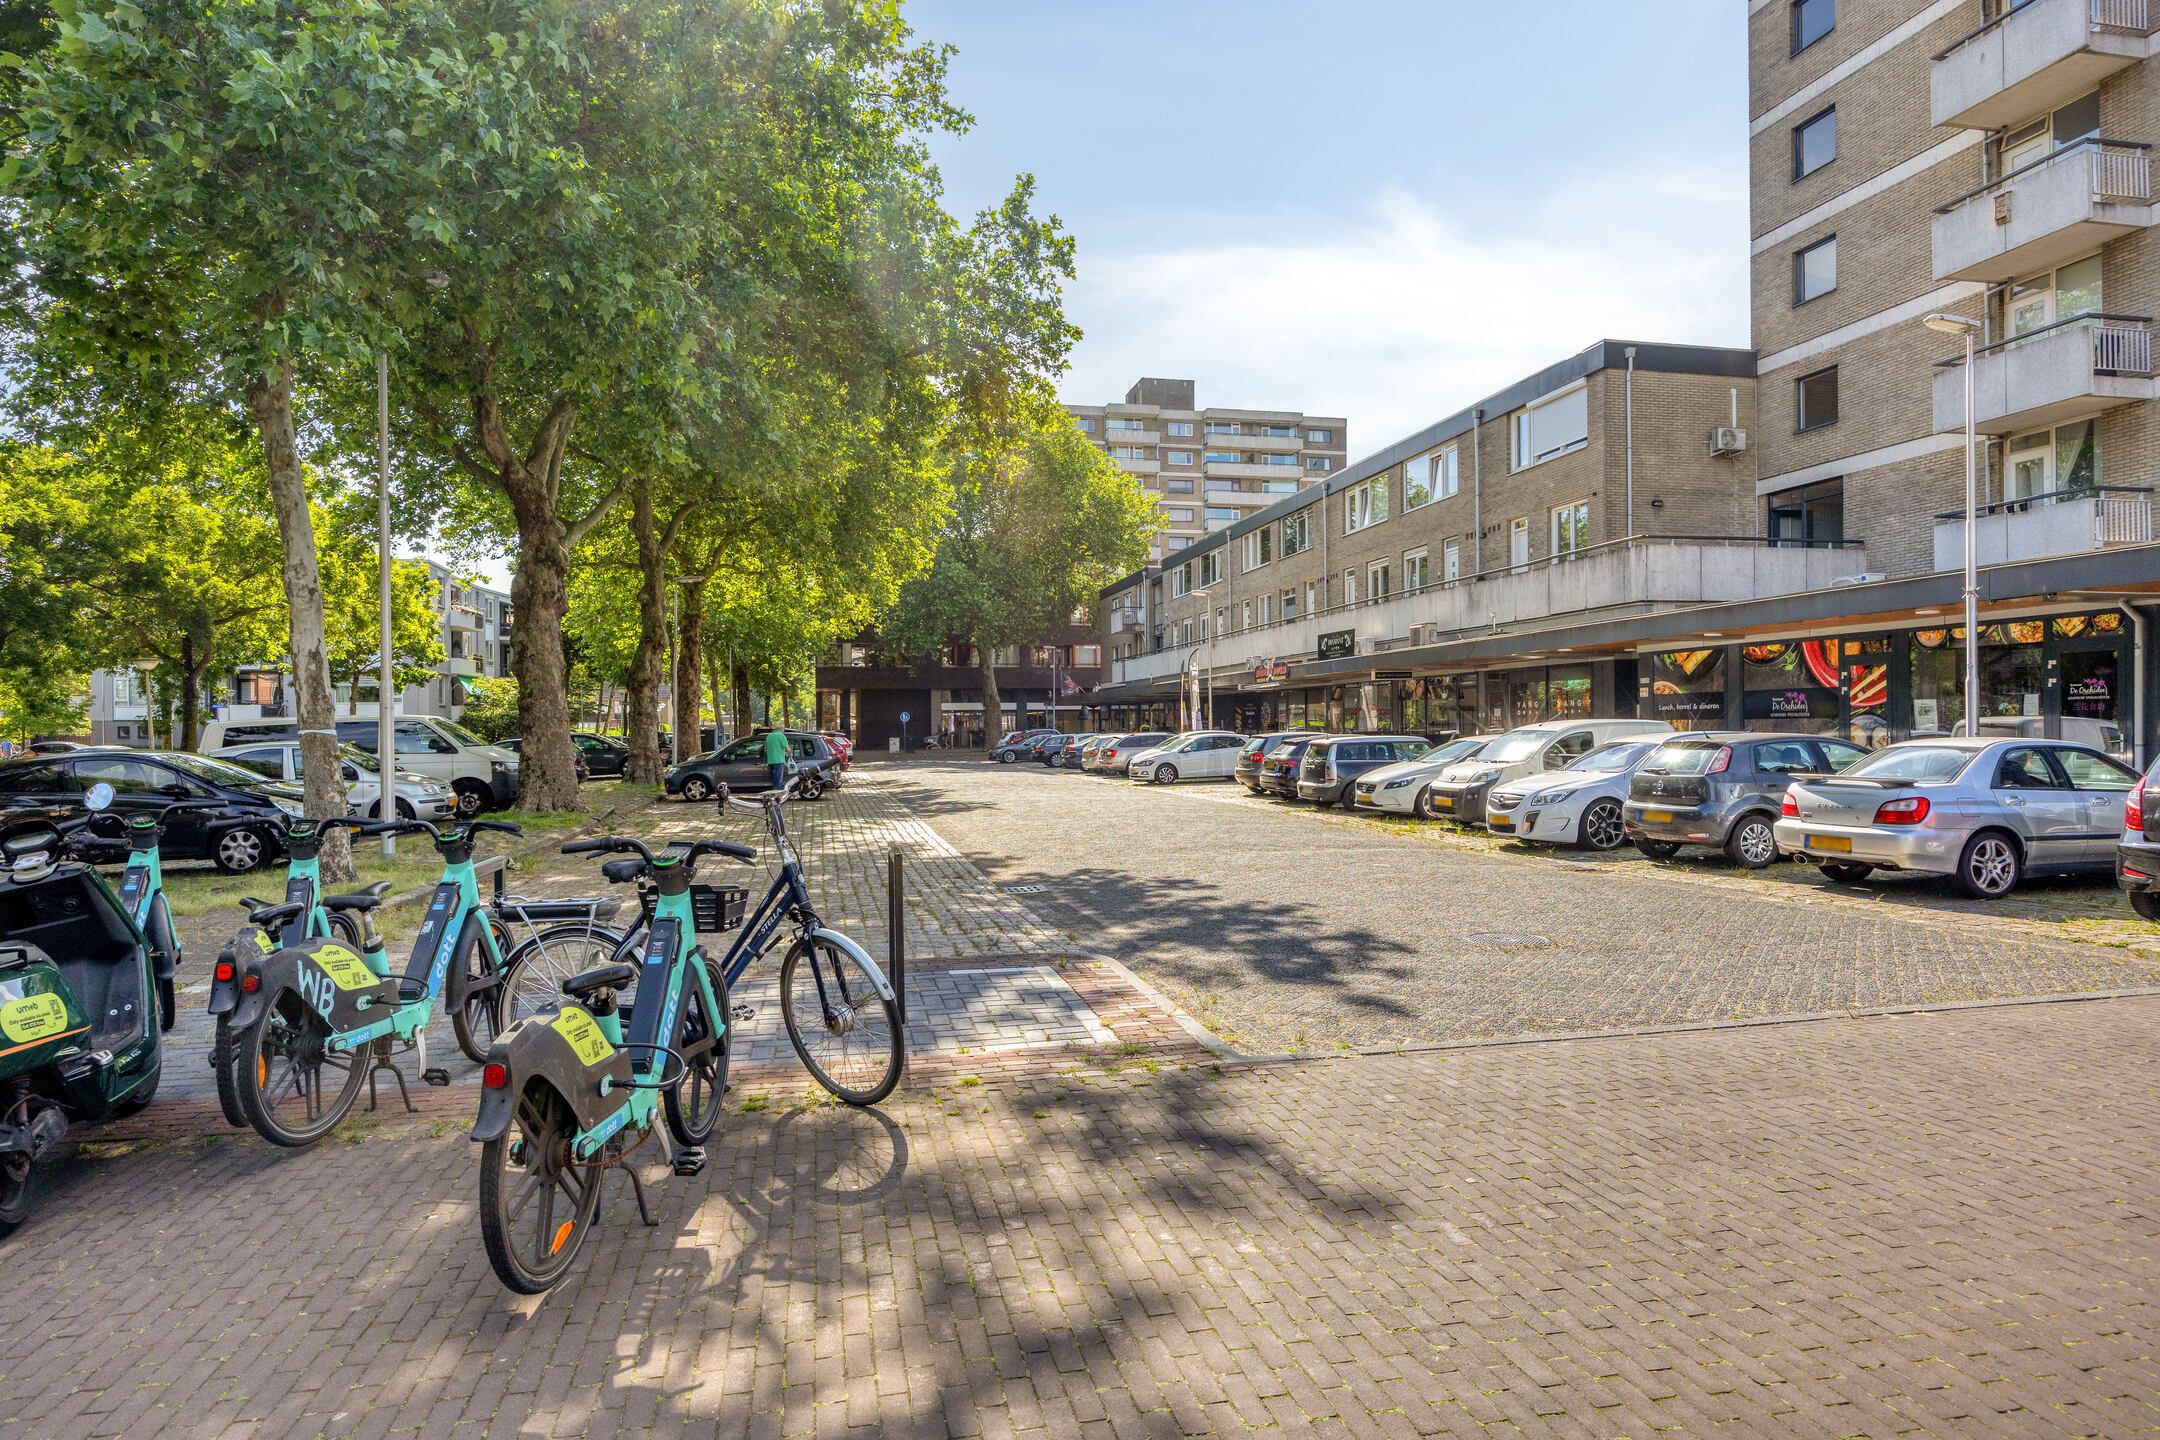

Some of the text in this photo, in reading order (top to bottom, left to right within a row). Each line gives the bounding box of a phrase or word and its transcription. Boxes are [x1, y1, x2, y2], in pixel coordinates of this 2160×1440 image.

[1772, 702, 1780, 710] De
[760, 907, 783, 935] STELLA
[436, 933, 456, 978] dott
[297, 960, 336, 1016] WB
[663, 988, 679, 1045] dott
[356, 1031, 370, 1043] dott
